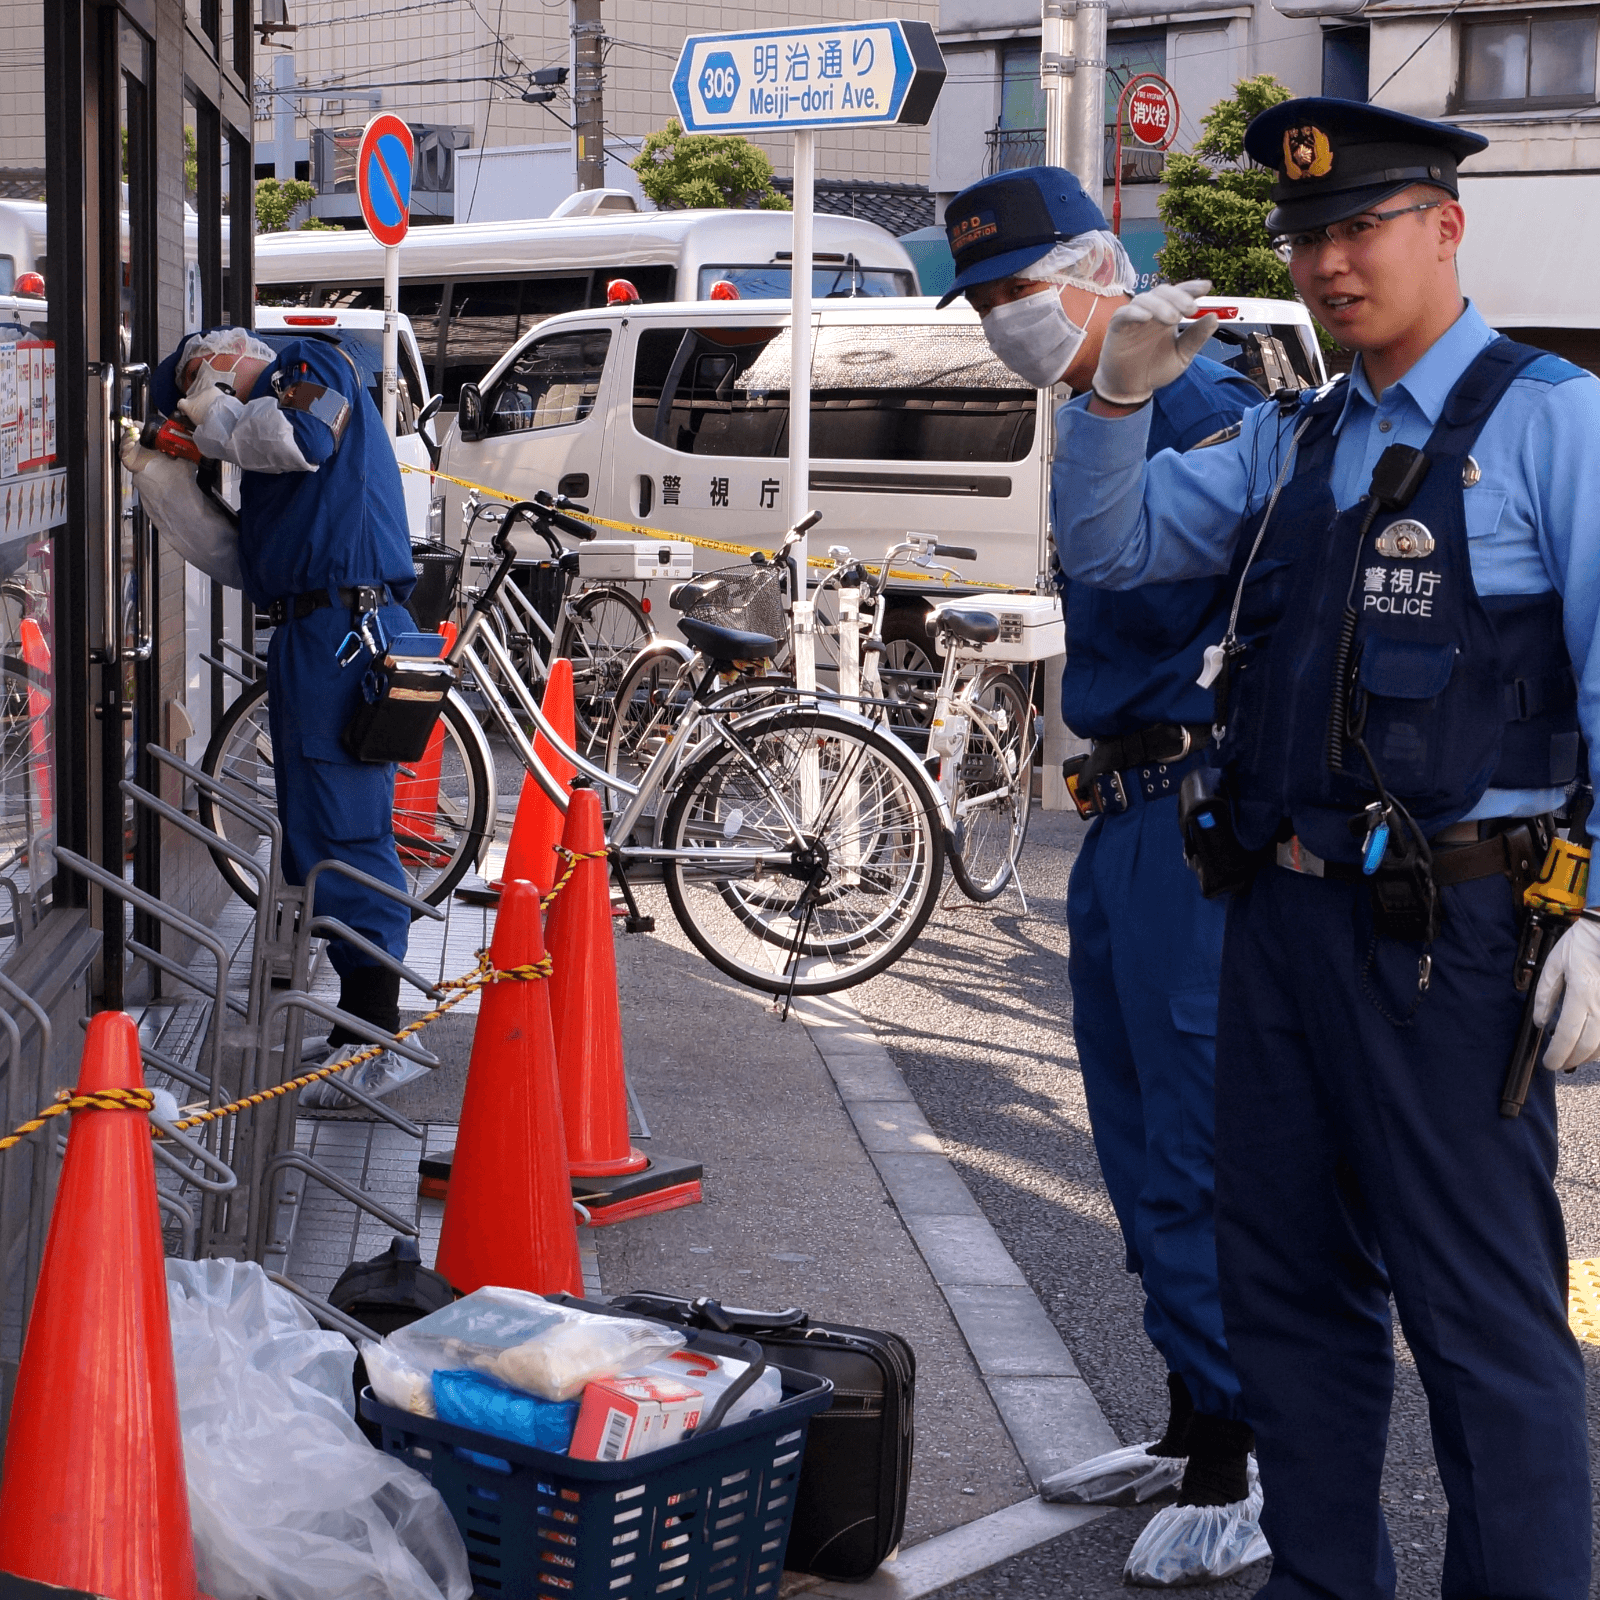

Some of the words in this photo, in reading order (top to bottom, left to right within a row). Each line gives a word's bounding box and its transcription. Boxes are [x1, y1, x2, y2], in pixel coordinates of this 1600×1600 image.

[753, 38, 875, 83] 明治通り
[704, 67, 734, 98] 306
[750, 83, 834, 119] Meiji-dori
[841, 82, 879, 110] Ave.
[1133, 101, 1167, 128] 消火栓
[662, 475, 780, 508] 警視庁
[1364, 566, 1441, 597] 警視庁
[1364, 595, 1433, 617] POLICE
